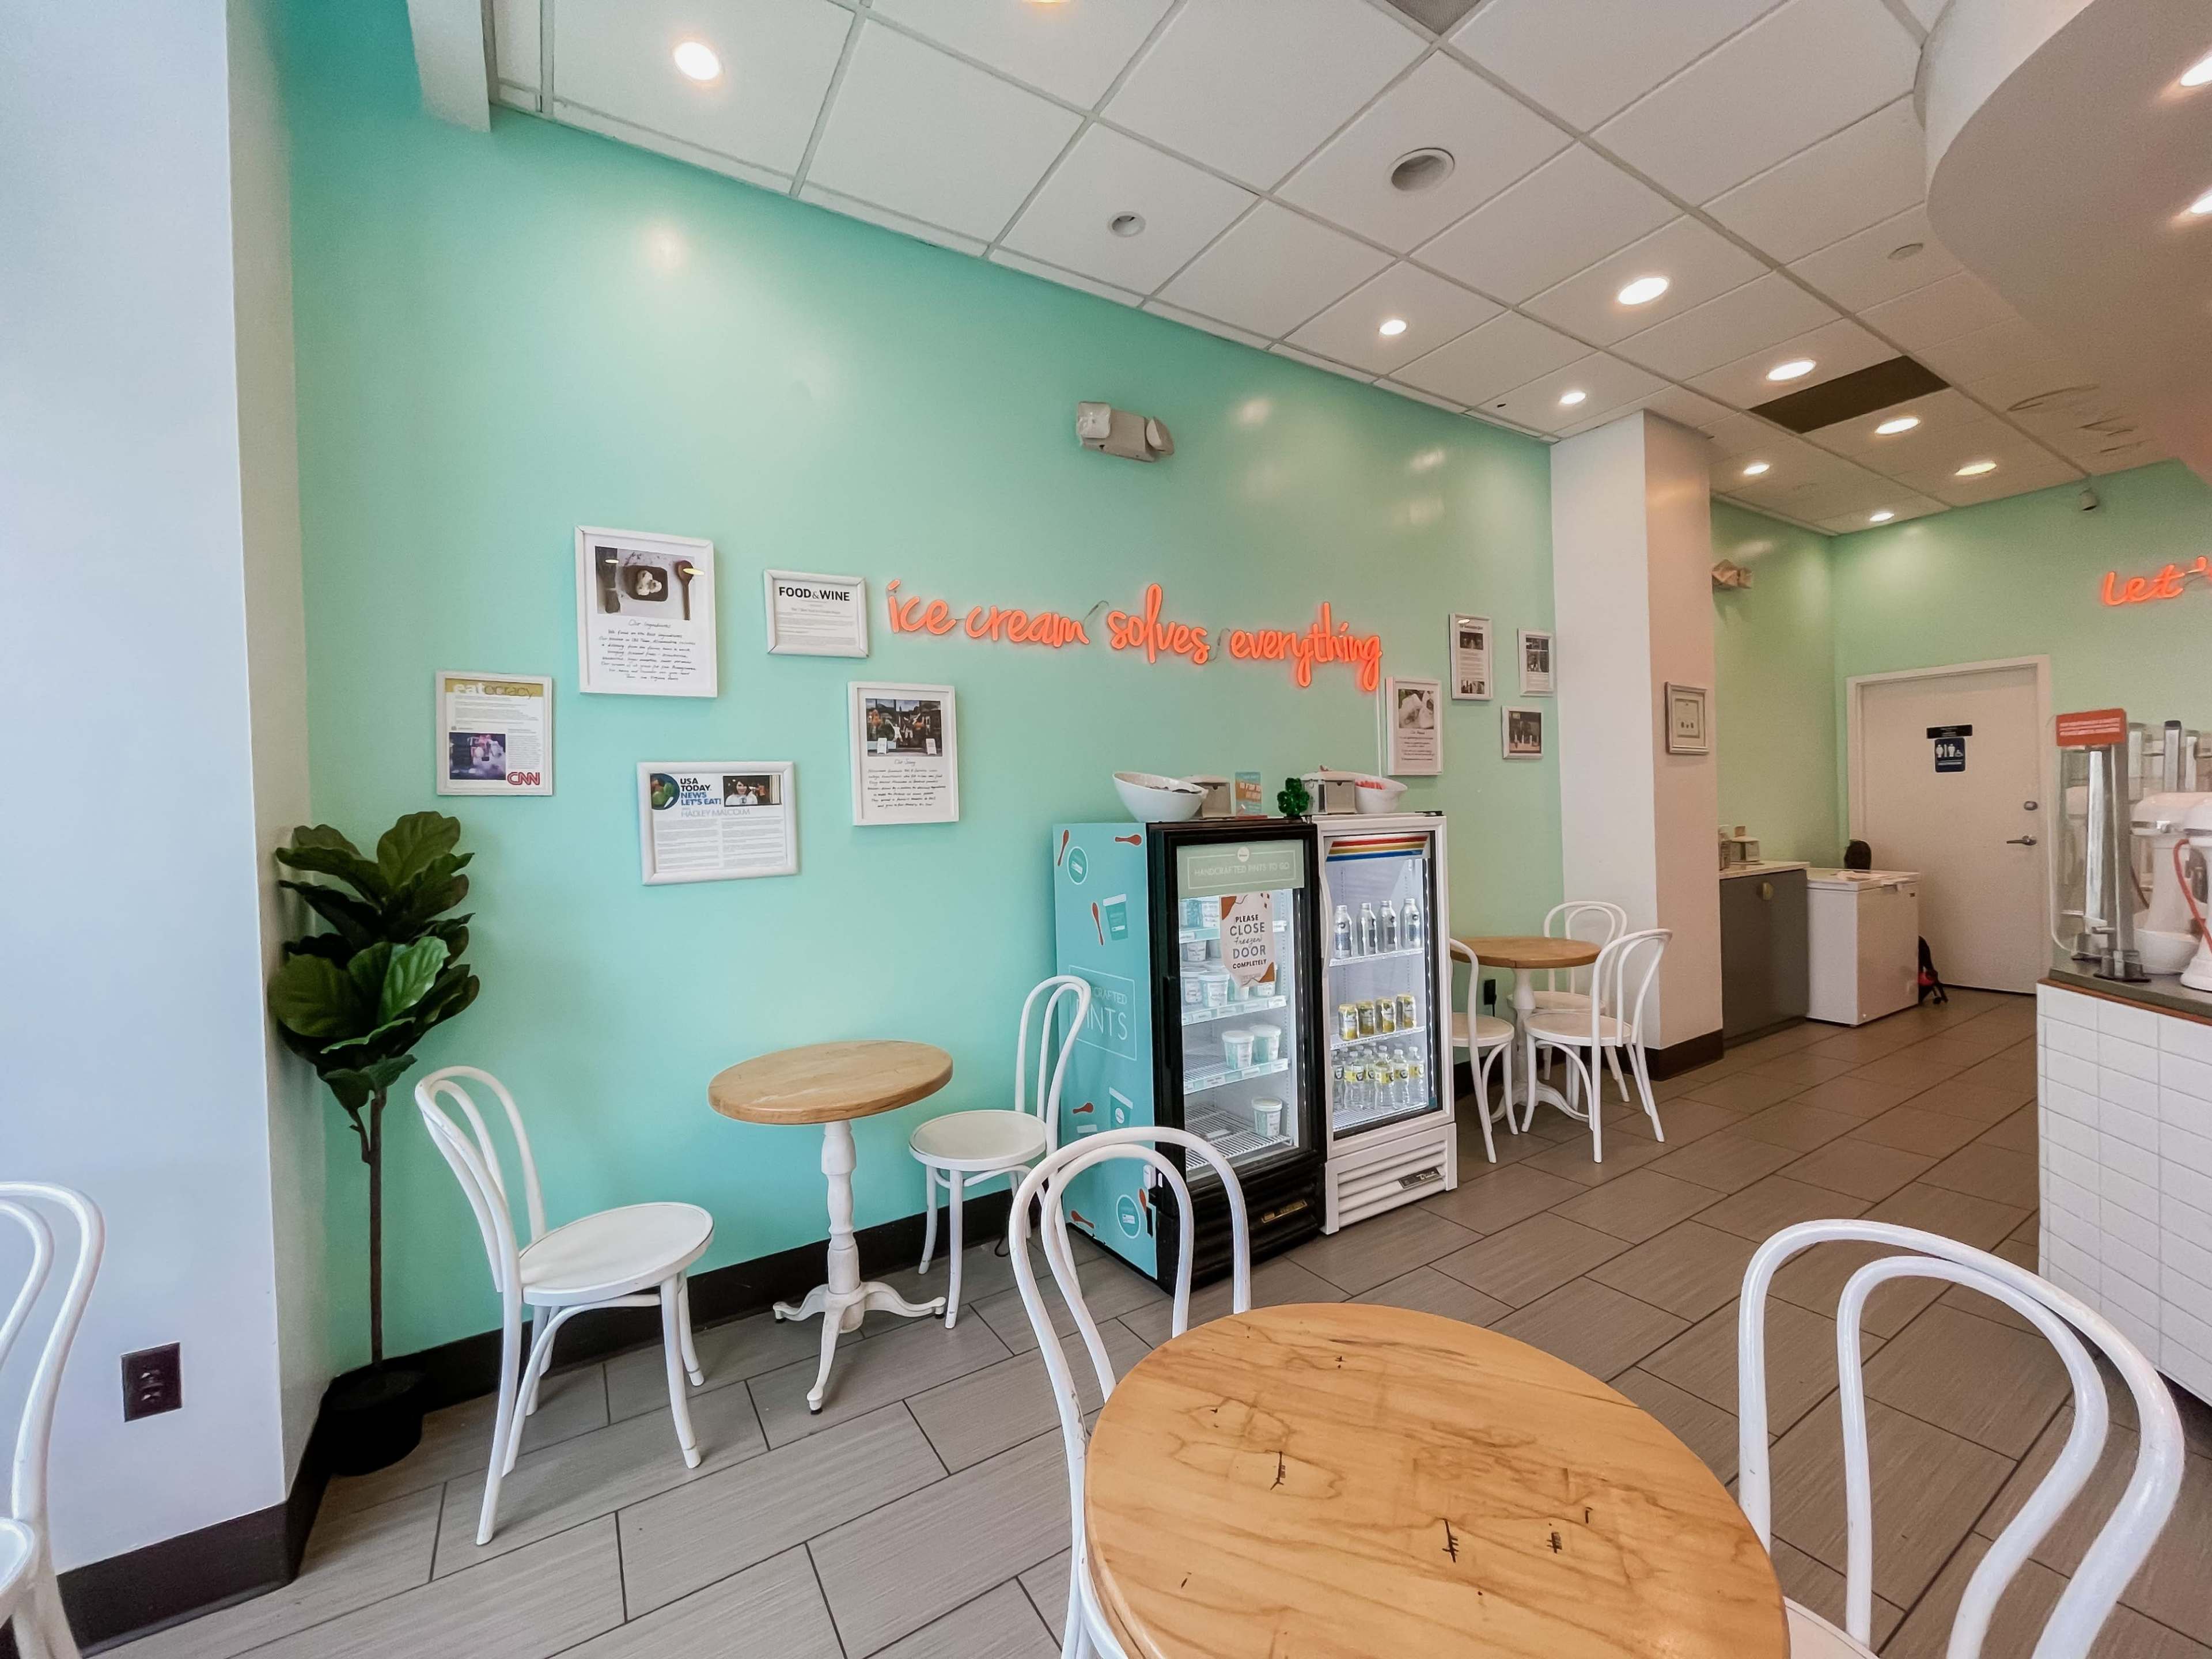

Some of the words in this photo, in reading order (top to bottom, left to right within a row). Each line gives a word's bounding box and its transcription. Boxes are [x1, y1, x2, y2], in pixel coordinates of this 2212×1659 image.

[2104, 556, 2212, 605] Let'
[887, 579, 957, 635] ice
[965, 605, 1089, 647] cream
[1107, 583, 1210, 664] solves
[1231, 601, 1382, 691] everything
[453, 682, 535, 699] eatocracy
[507, 771, 540, 786] CNN
[1194, 865, 1247, 876] HANDCRAFTED
[1268, 863, 1278, 871] TO
[1279, 862, 1290, 870] GO
[1230, 922, 1265, 935] CLOSE
[1233, 937, 1263, 948] freezer
[1233, 945, 1266, 959] DOOR
[1233, 959, 1267, 968] COMPLETELY
[1076, 998, 1128, 1040] INTS
